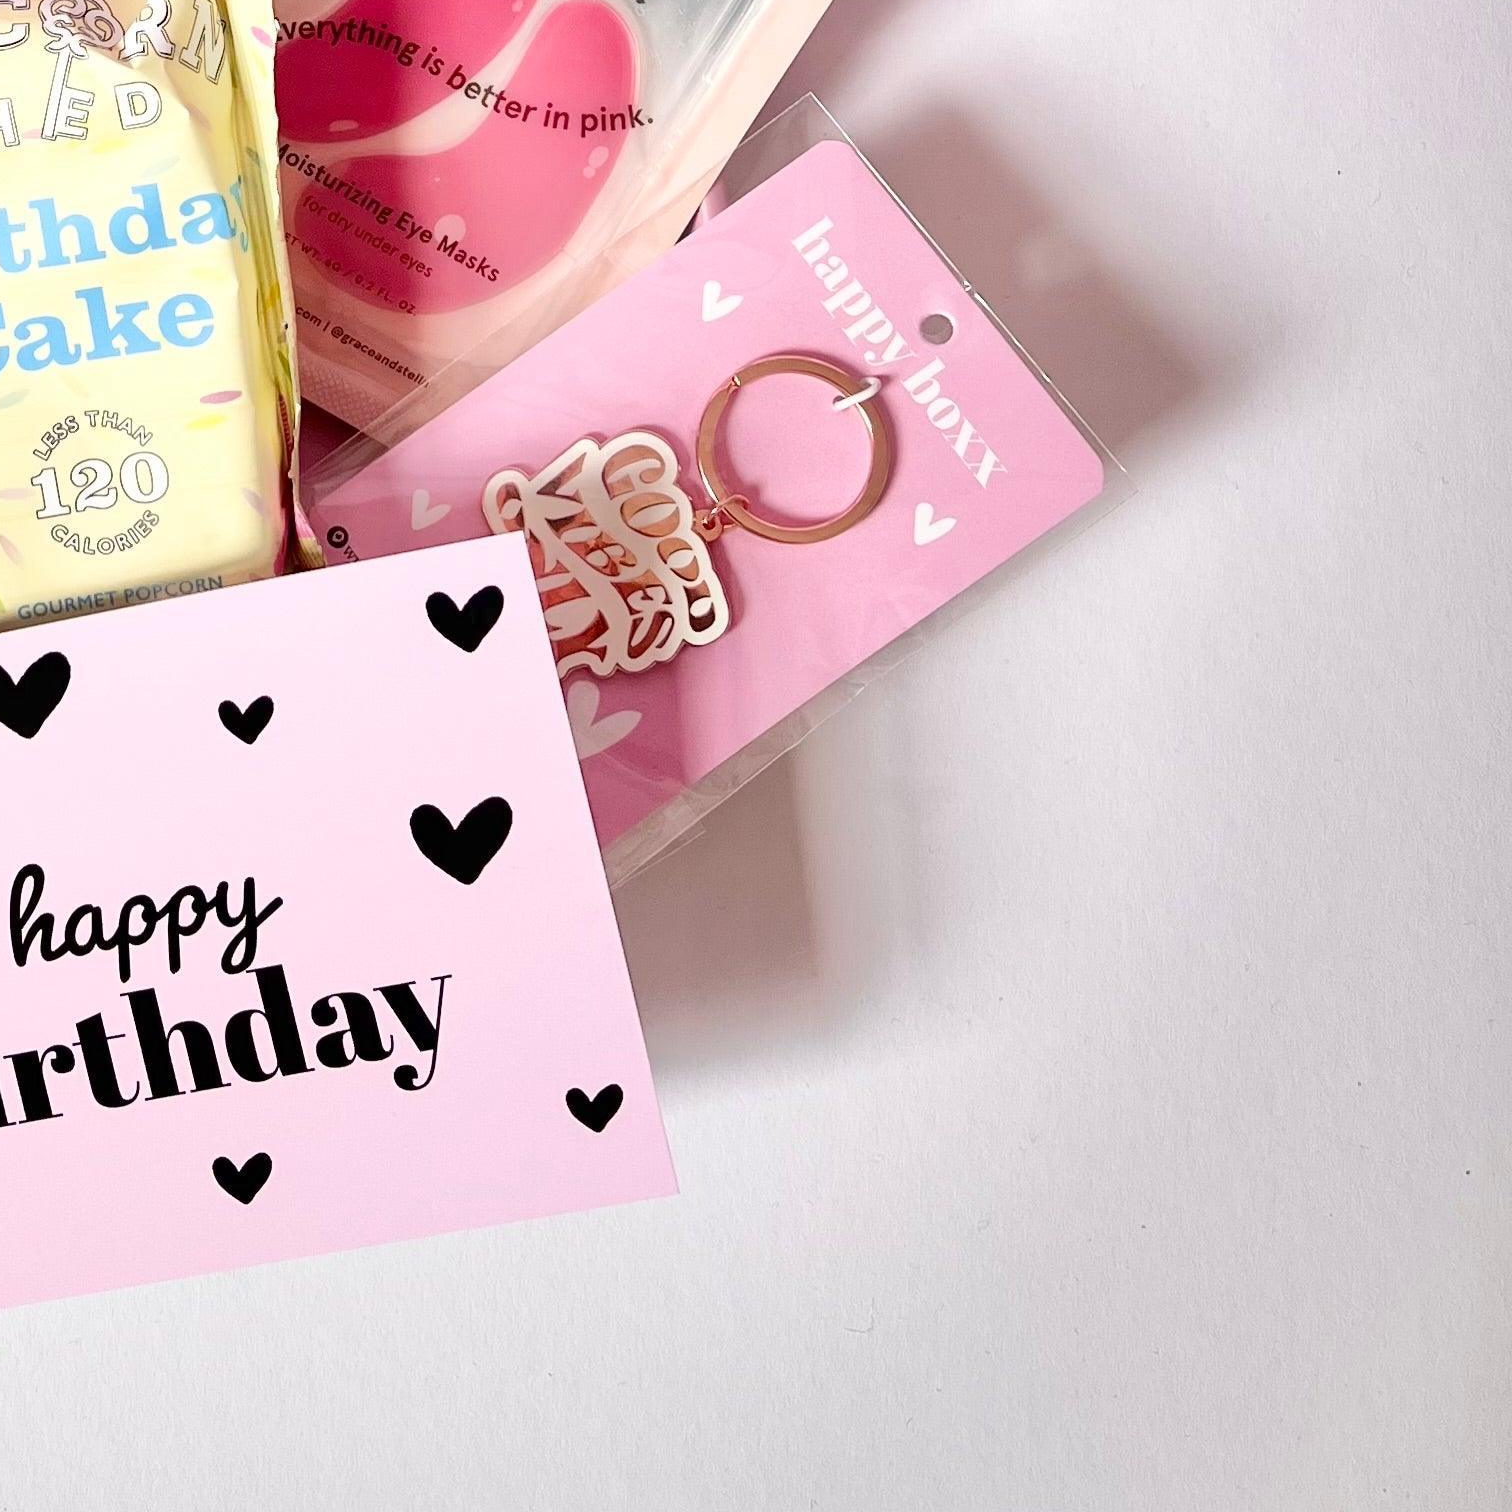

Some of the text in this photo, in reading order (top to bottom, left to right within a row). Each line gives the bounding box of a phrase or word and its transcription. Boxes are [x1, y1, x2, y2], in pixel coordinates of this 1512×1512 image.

[276, 17, 655, 138] verything is better in pink.
[302, 195, 433, 278] for dry under eyes
[395, 210, 433, 244] Eye
[436, 234, 501, 283] Masks
[791, 215, 1009, 489] happy boxx
[32, 409, 154, 462] LESS THAN
[30, 451, 170, 520] 120
[50, 509, 160, 556] CALORIES
[600, 444, 717, 633] GOOD
[17, 575, 224, 621] GOURMET POPCORN
[8, 863, 284, 983] happy
